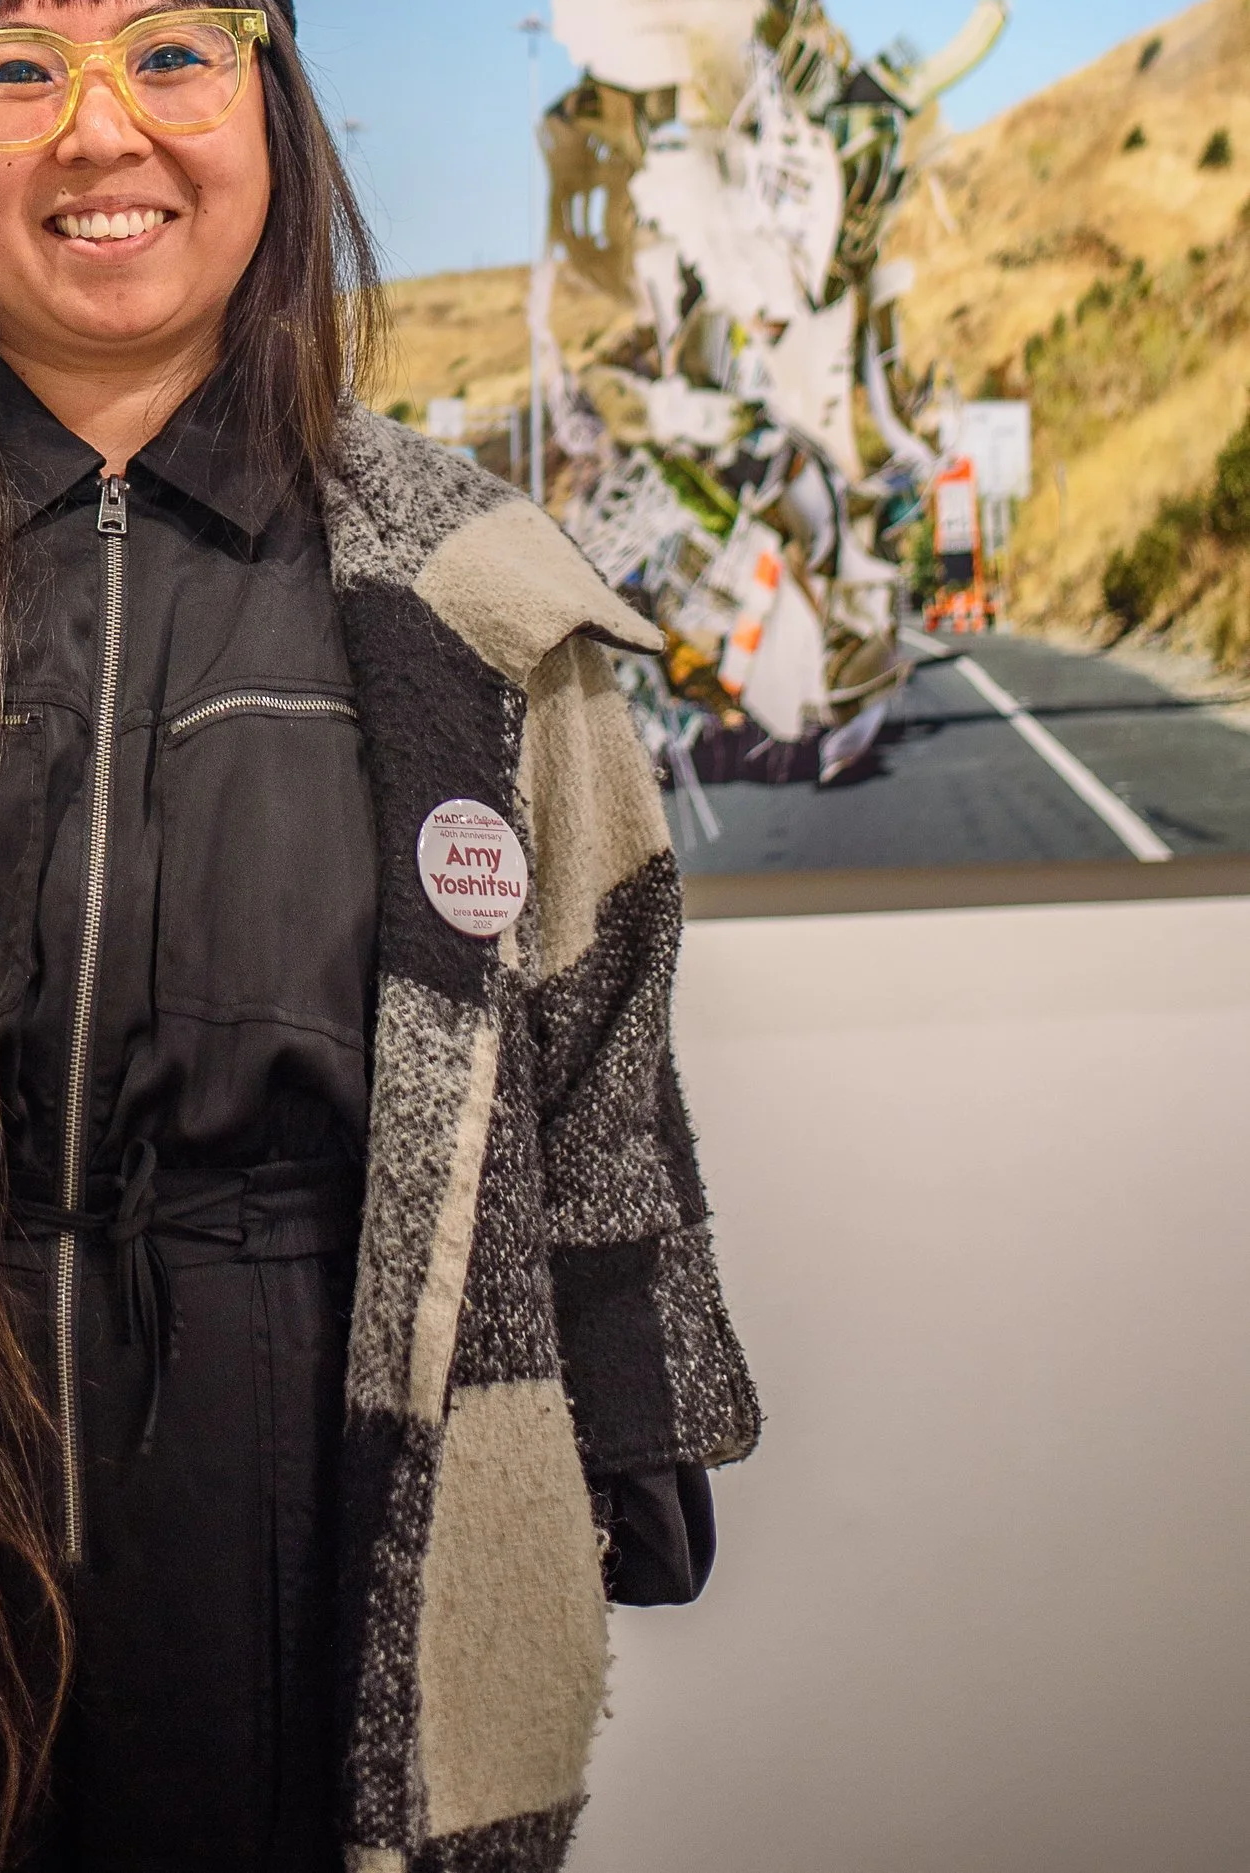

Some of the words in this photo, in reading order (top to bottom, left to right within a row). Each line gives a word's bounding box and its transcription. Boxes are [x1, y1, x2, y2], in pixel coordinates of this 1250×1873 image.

[433, 814, 465, 825] MADE
[440, 830, 458, 839] 40th
[459, 831, 503, 842] Anniversary
[446, 842, 502, 874] Amy
[429, 873, 521, 898] Yoshitsu
[453, 907, 472, 917] brea
[472, 909, 509, 919] GALLERY
